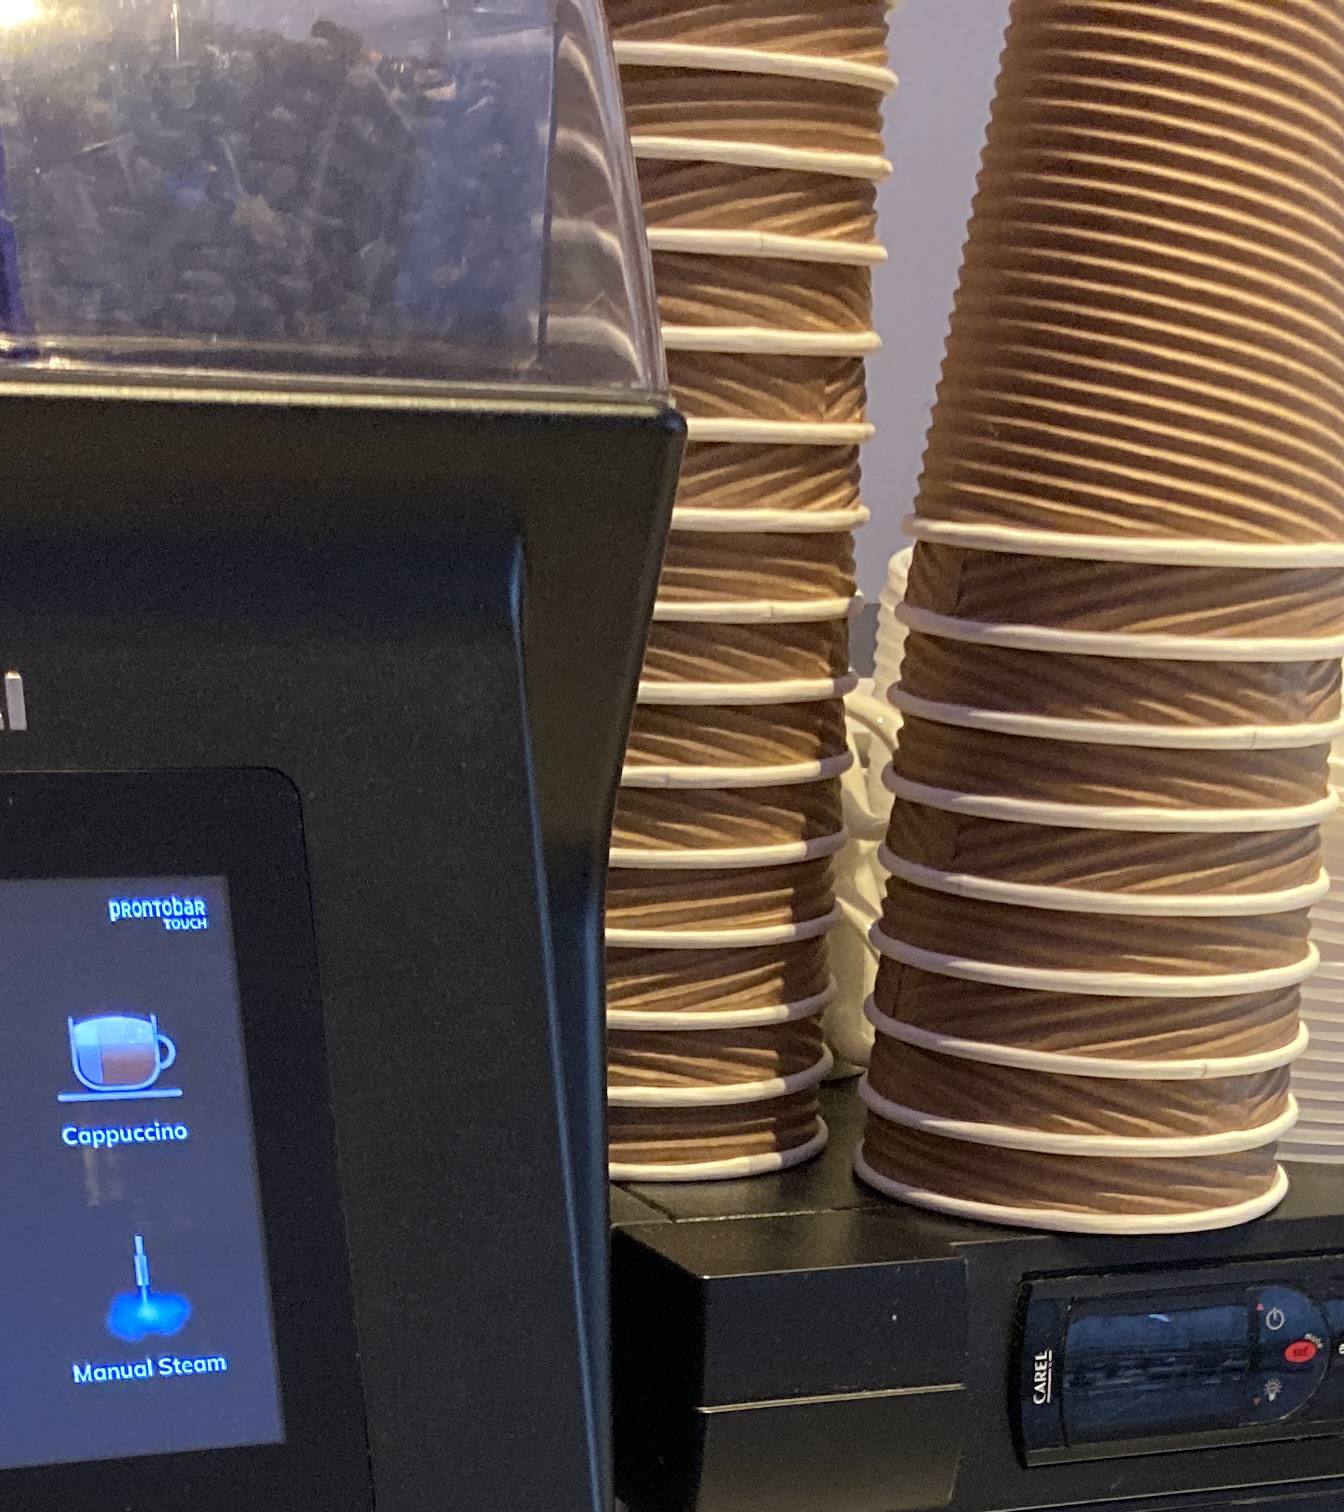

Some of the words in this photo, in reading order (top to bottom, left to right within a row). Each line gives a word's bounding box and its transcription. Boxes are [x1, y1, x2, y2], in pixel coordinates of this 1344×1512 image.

[163, 917, 208, 930] TOUCH
[62, 1122, 188, 1148] Cappuccino
[72, 1358, 154, 1384] Manual
[157, 1355, 229, 1377] Steam
[1033, 1350, 1048, 1404] CAREL
